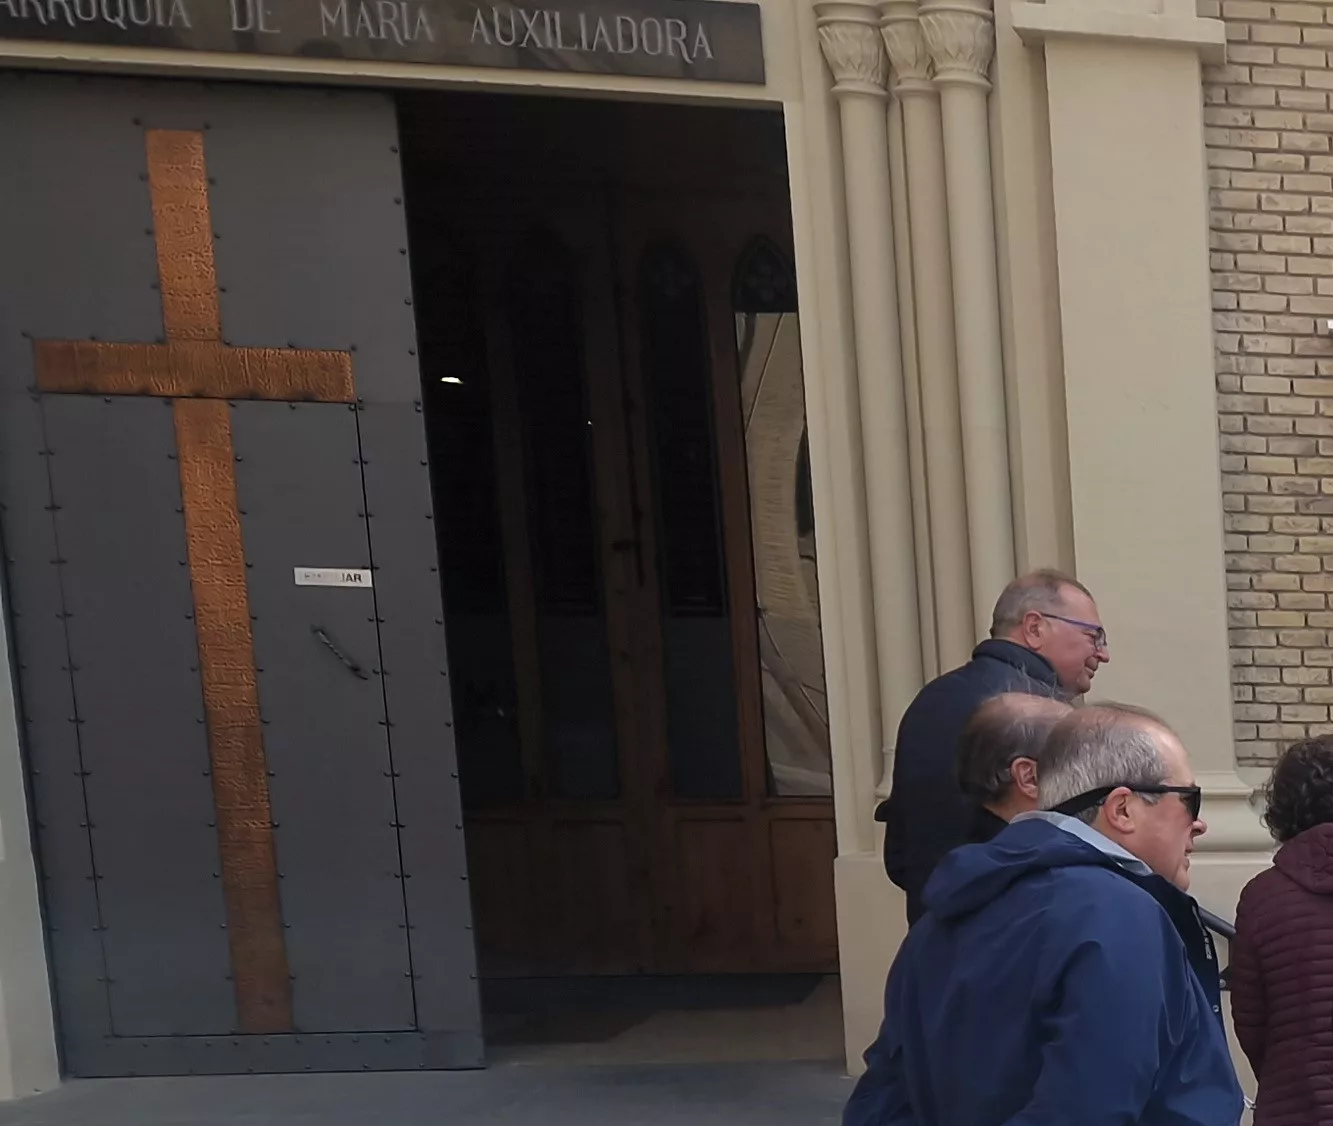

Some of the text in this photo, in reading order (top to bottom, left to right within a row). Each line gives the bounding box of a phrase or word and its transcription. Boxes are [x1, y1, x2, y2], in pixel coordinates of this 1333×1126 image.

[229, 0, 281, 33] DE
[320, 0, 434, 46] MARIA
[470, 7, 714, 64] AUXILIADORA
